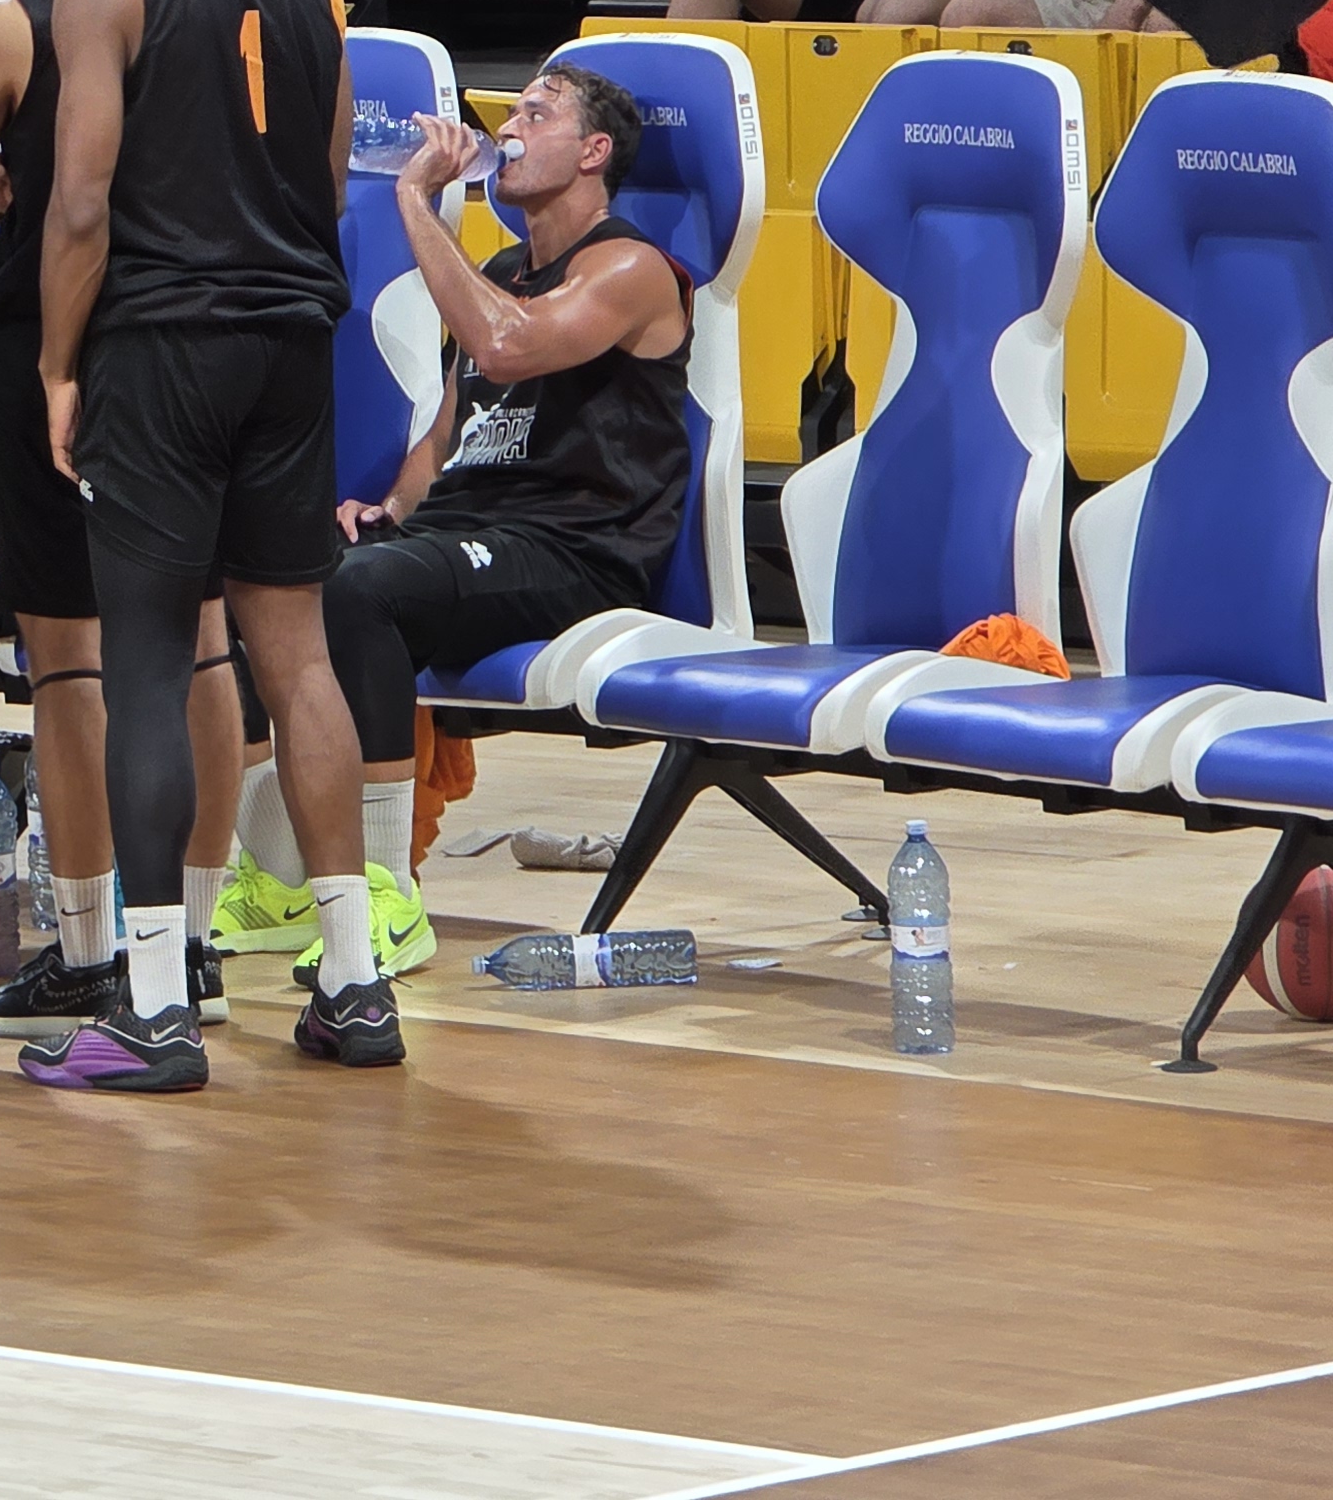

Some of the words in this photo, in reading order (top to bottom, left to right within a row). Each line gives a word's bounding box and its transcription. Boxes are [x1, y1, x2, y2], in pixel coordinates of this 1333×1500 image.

[239, 10, 267, 134] 1
[353, 99, 389, 120] ABRIA
[641, 106, 688, 127] LABRIA
[903, 123, 951, 145] REGGIO
[953, 125, 1015, 149] CALABRIA
[1176, 149, 1228, 171] REGGIO
[1232, 150, 1297, 176] CALABRIA
